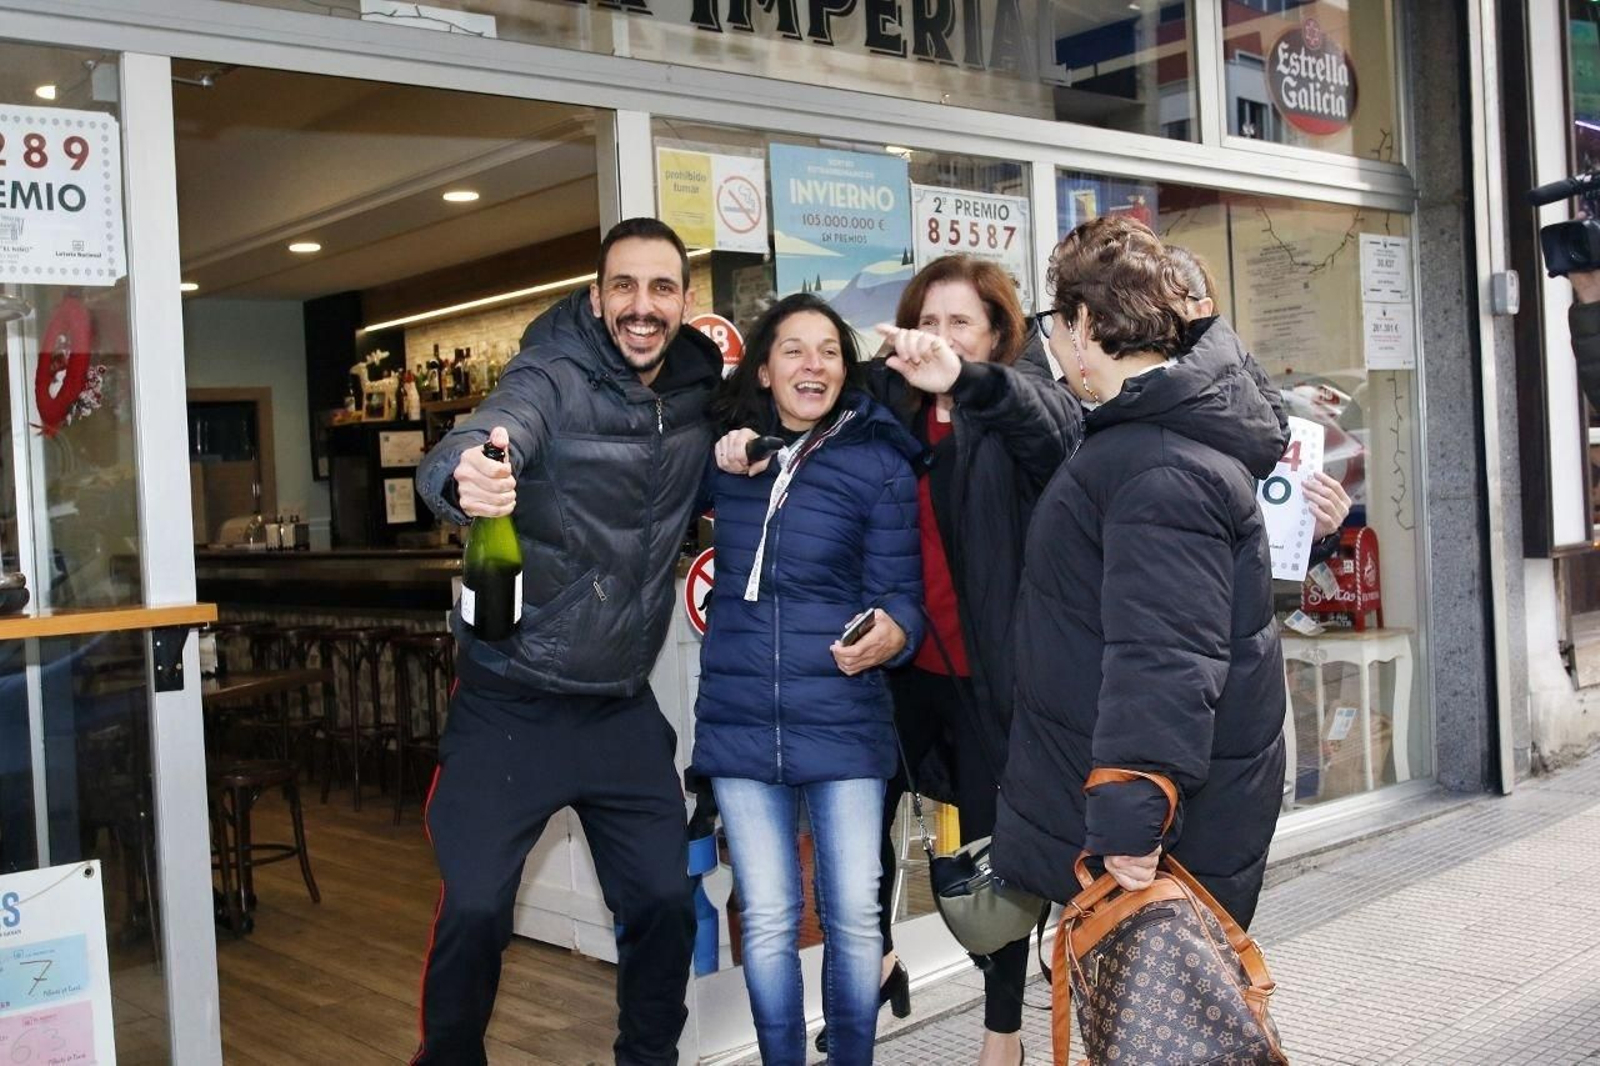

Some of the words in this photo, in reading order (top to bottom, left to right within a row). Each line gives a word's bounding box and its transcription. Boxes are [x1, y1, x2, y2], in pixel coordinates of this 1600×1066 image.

[1277, 41, 1349, 87] Estrella
[1281, 76, 1346, 118] Galicia
[0, 131, 90, 171] 89
[665, 170, 707, 182] prohibido
[673, 183, 700, 194] fumar
[790, 178, 895, 212] INVIERNO
[802, 213, 875, 231] 105.000.000
[955, 199, 1010, 221] PREMIO
[822, 232, 832, 242] EN
[834, 232, 868, 245] PREMIOS
[928, 217, 1017, 250] 85587
